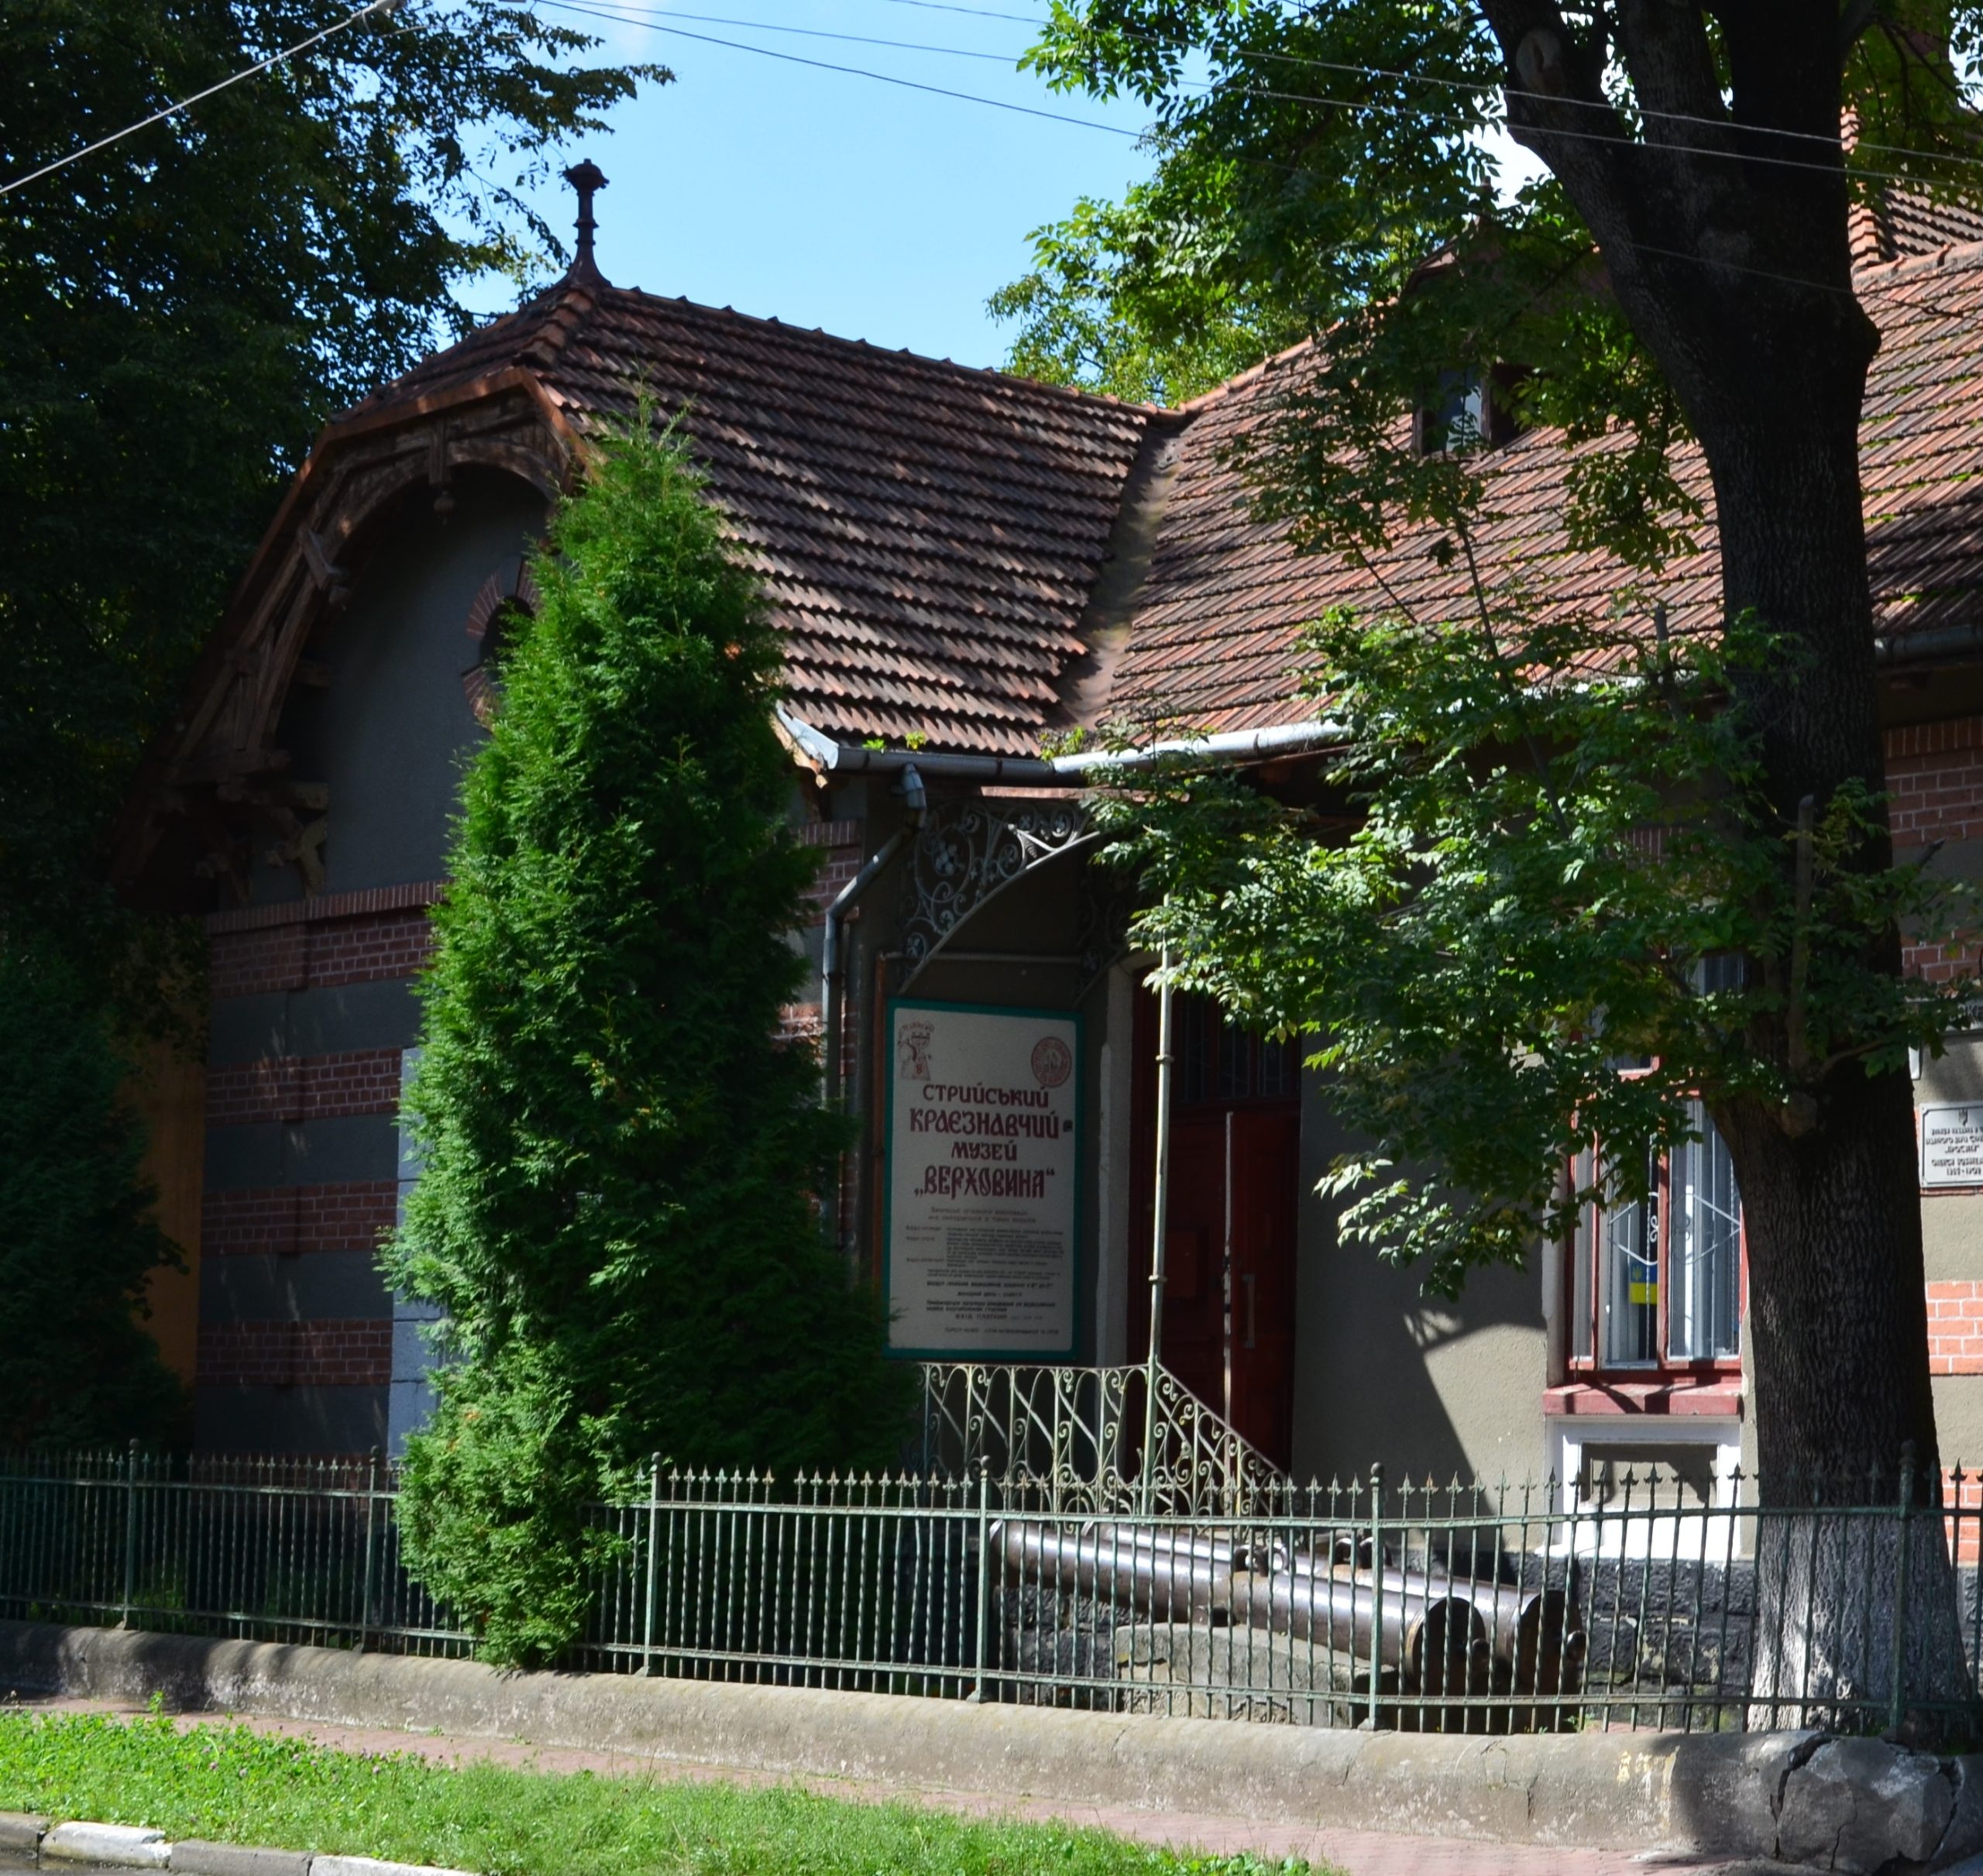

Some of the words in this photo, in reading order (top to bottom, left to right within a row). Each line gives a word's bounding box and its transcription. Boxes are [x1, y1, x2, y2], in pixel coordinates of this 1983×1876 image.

[923, 1082, 1049, 1108] СТРИЙСЬКИЙ
[909, 1108, 1059, 1139] КРАЄЗНАВЧИЙ
[951, 1140, 1017, 1161] МУЗЕЙ
